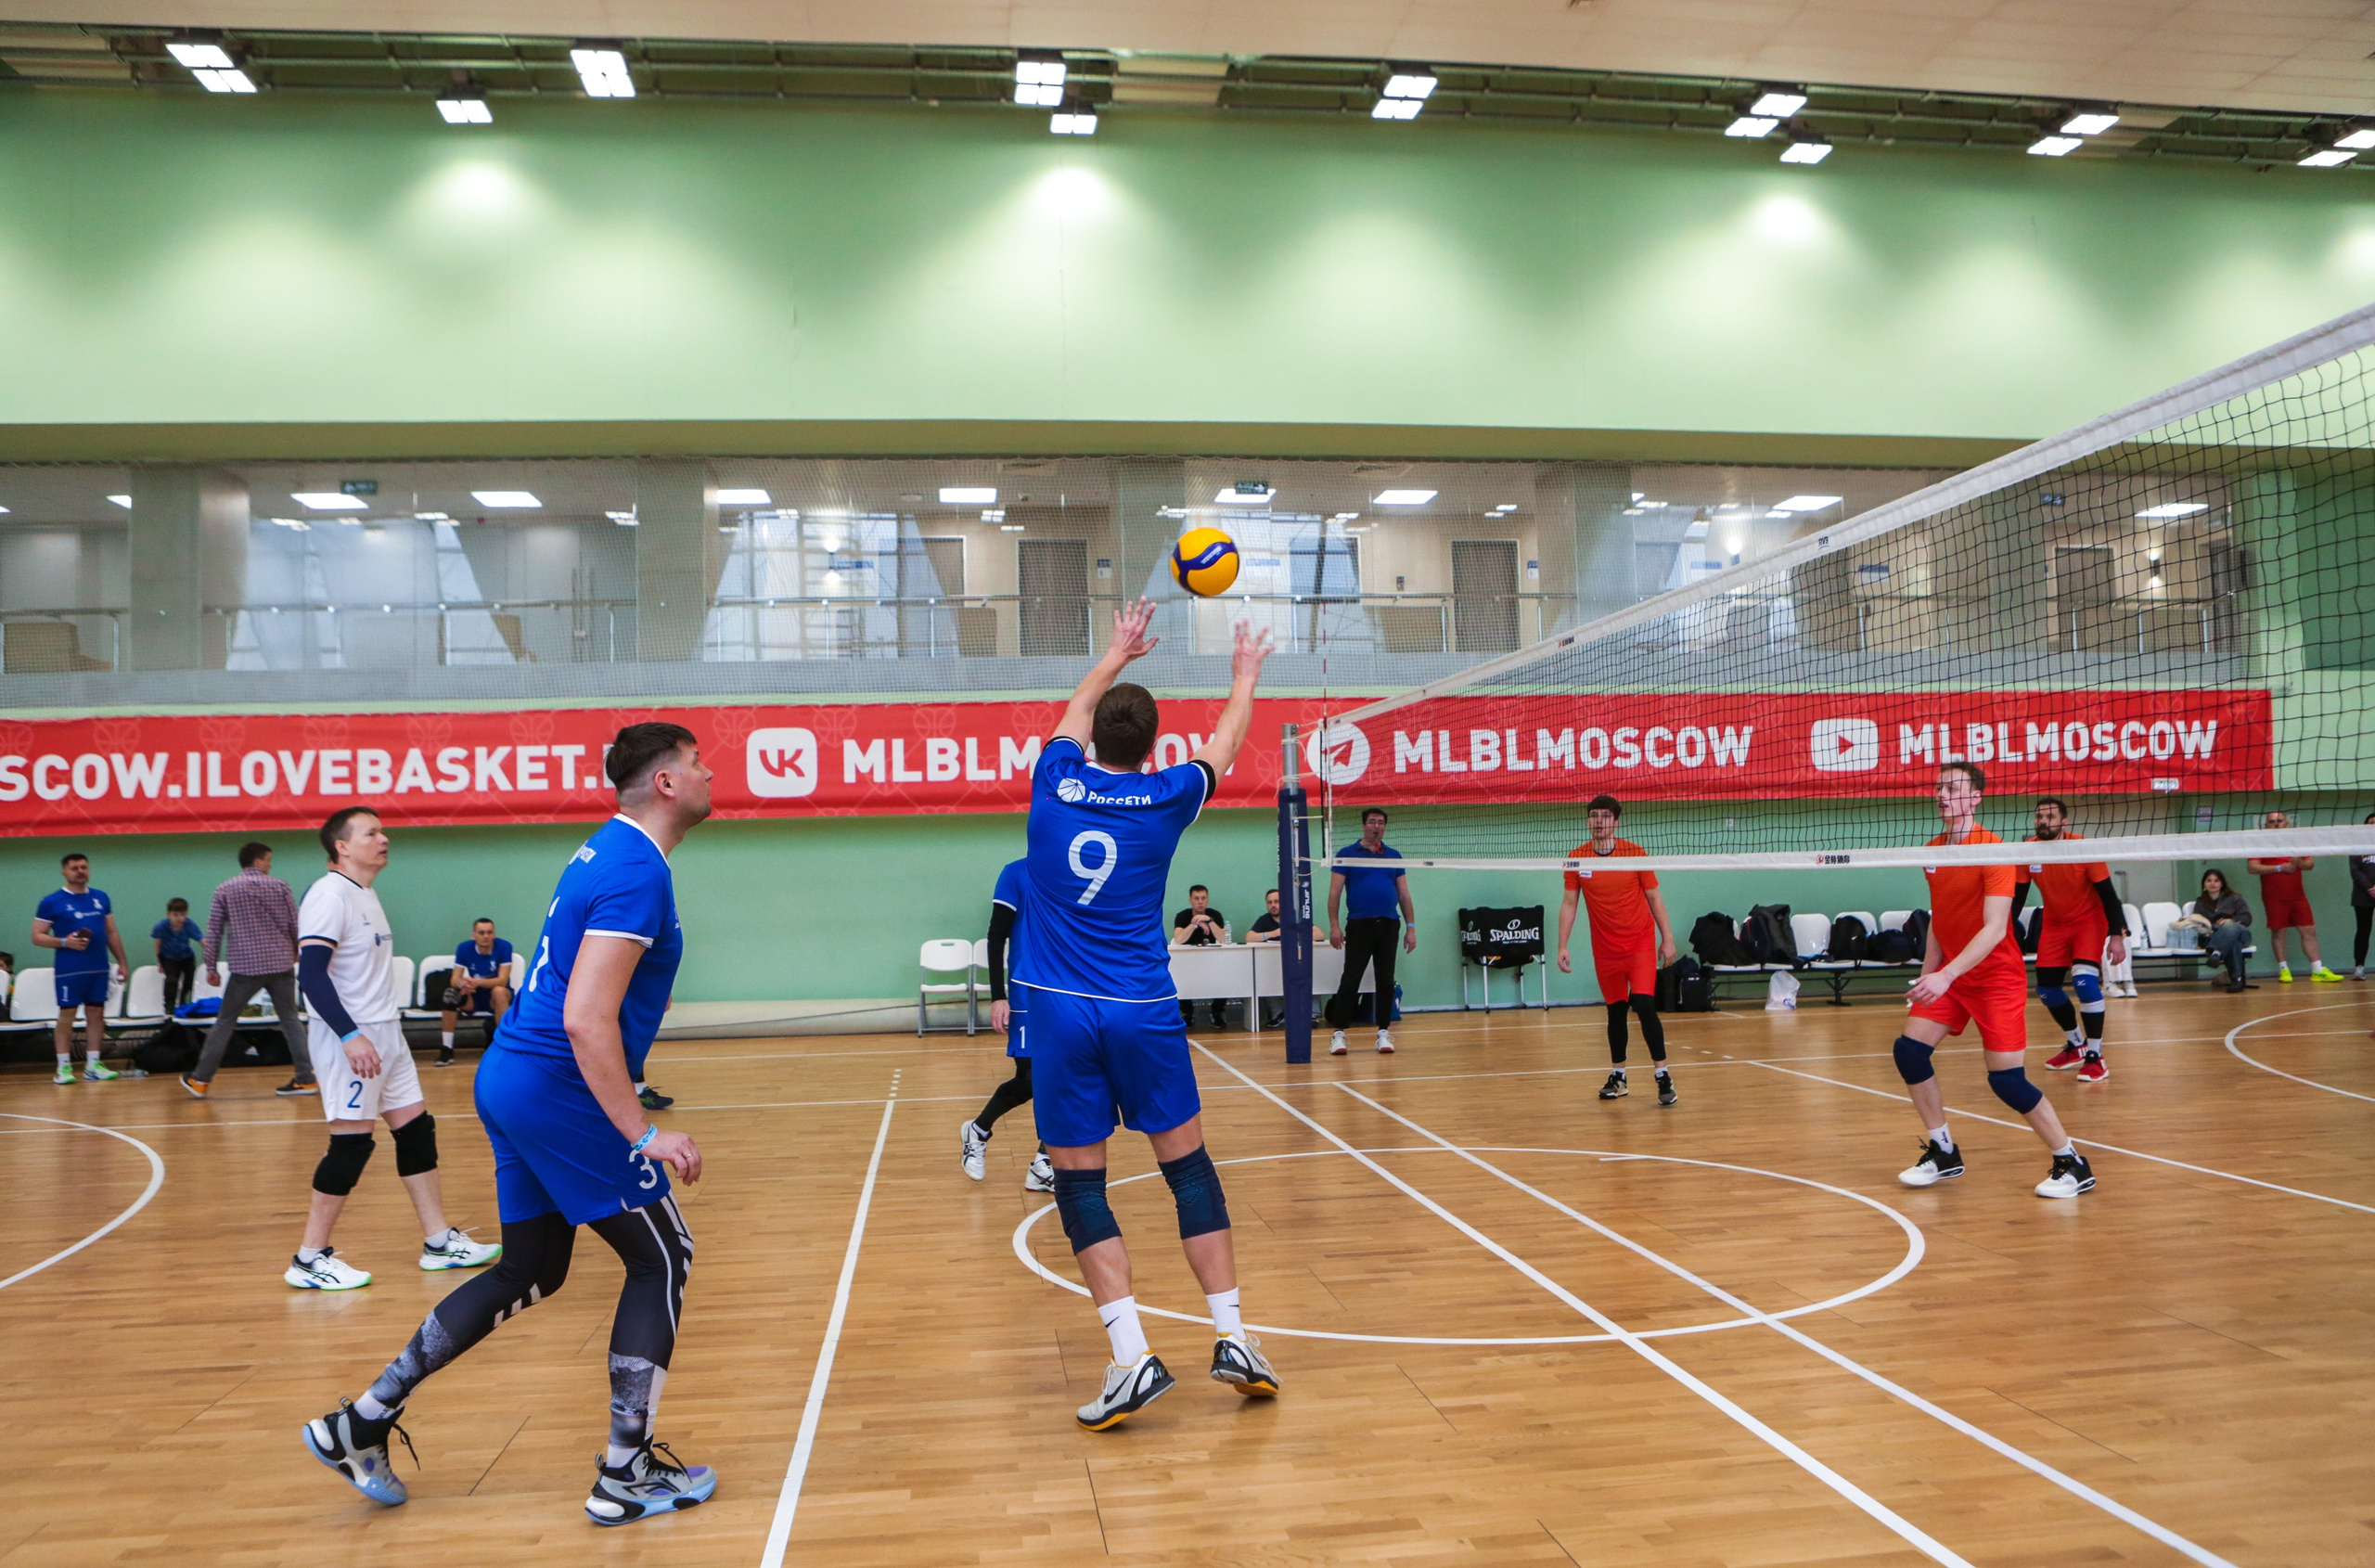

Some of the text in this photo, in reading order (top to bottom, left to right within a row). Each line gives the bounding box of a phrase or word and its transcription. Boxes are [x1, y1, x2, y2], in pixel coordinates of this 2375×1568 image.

[1394, 725, 1753, 774] MLBLMOSCOW
[1899, 719, 2218, 765] MLBLMOSCOW
[1068, 830, 1118, 906] 9
[1490, 927, 1540, 942] SPALDING
[1020, 1025, 1025, 1048] 1
[347, 1080, 363, 1108] 2
[629, 1150, 658, 1189] 3
